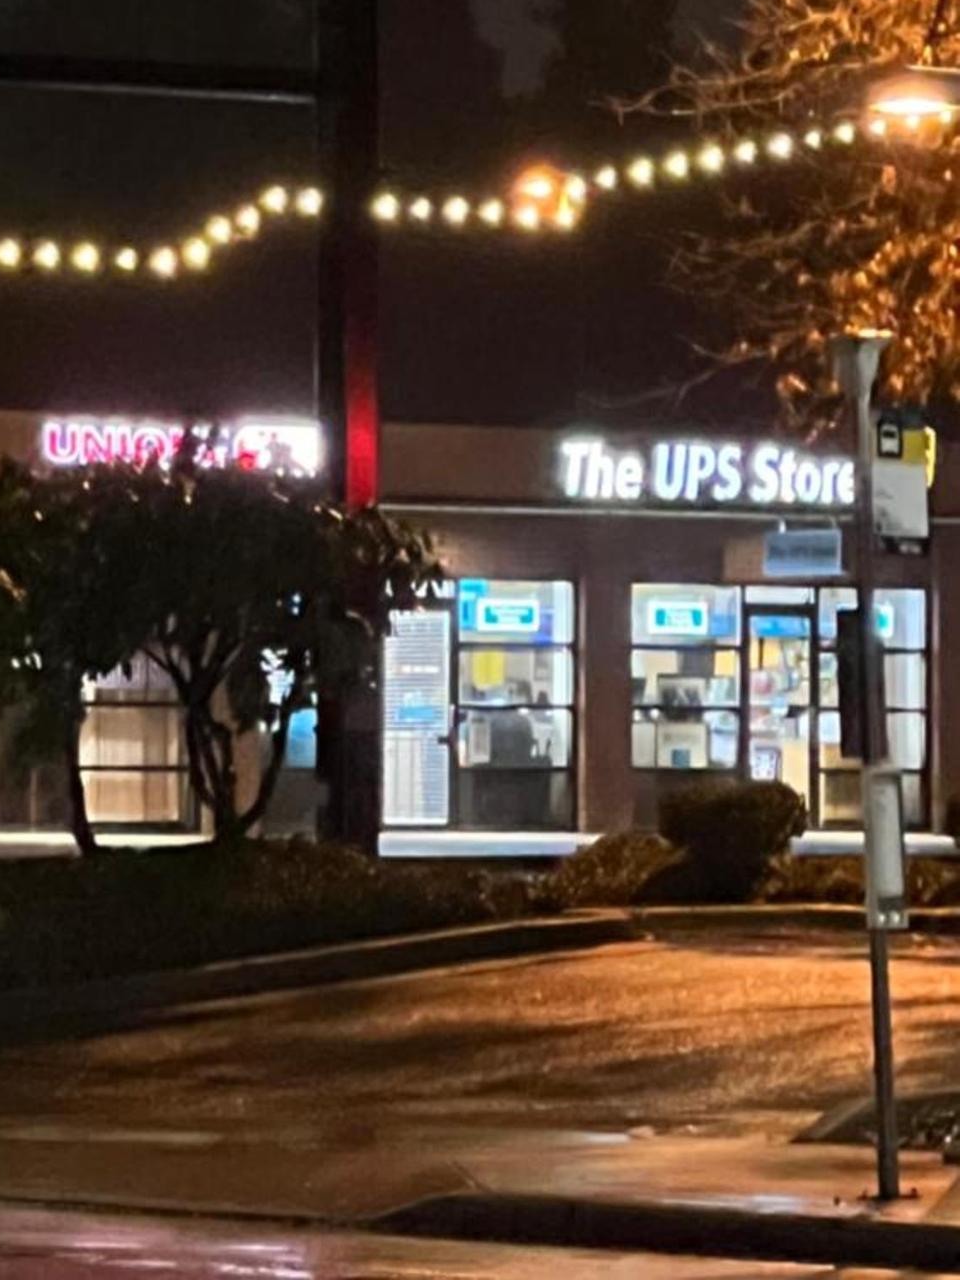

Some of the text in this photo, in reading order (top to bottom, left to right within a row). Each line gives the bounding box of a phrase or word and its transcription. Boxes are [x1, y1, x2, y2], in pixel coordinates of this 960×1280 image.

[561, 439, 855, 505] The UPS Store
